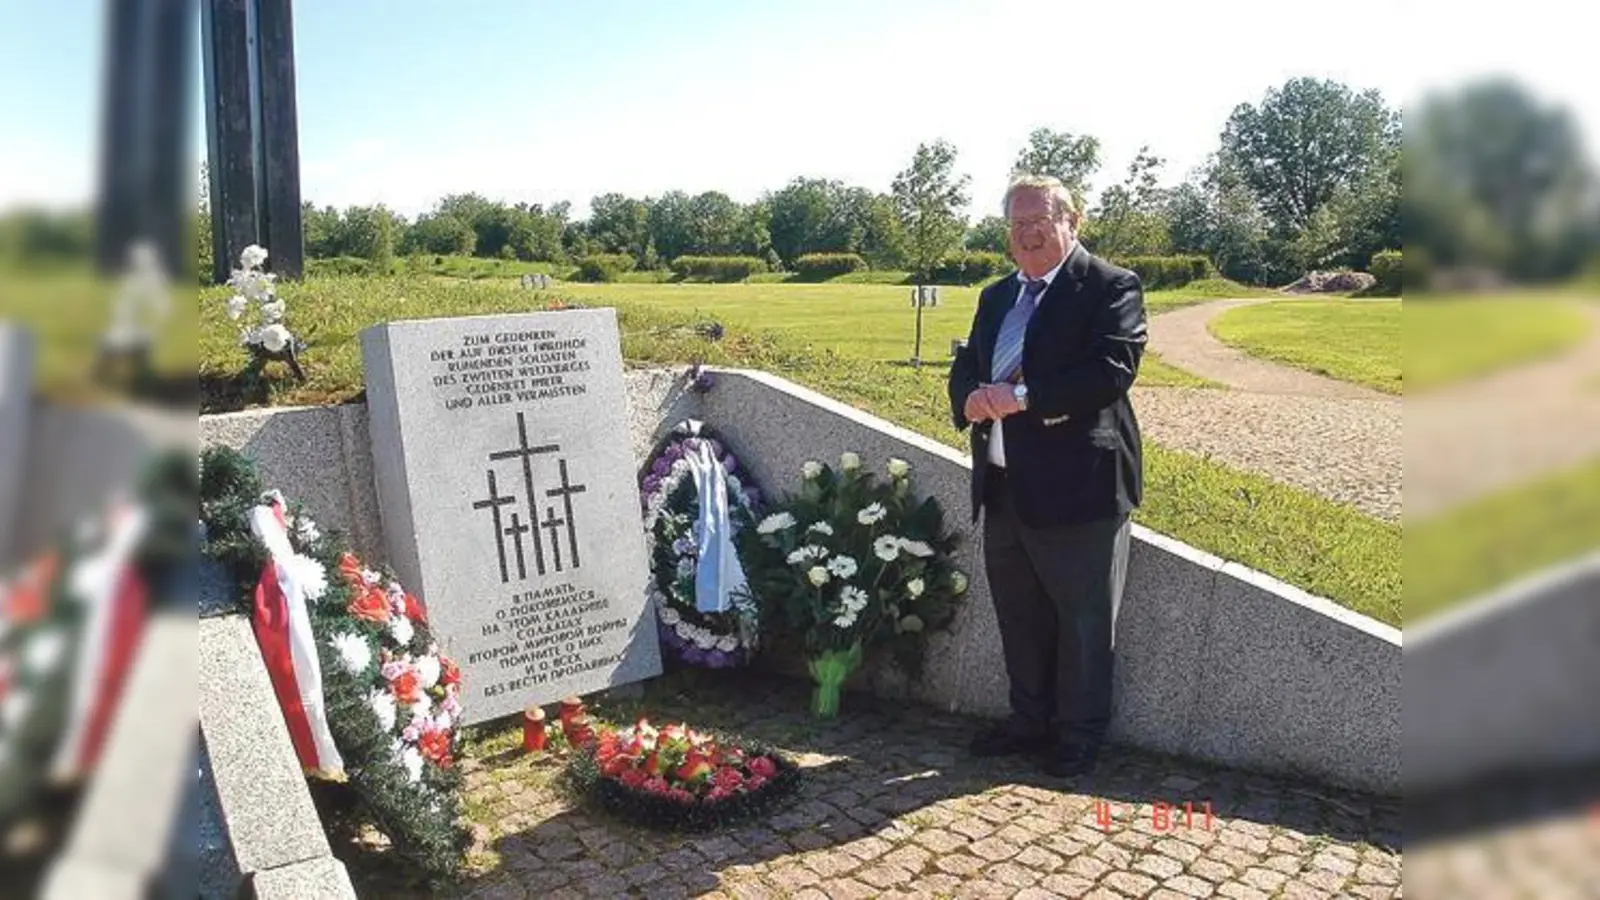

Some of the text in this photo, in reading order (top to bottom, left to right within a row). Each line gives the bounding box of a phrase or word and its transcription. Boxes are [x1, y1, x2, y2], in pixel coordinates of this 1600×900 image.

[463, 330, 556, 346] ZUM GEDENKEN
[430, 339, 586, 361] DER AUF DIESEM FRIEDHOF
[448, 350, 576, 372] RUHENDEN SOLDATEN
[433, 361, 591, 386] DES ZWEITEN WELTKRIEGES
[446, 384, 586, 410] UND ALLER VERMISSTEN
[513, 583, 575, 603] В ПАМЯТЬ
[496, 610, 505, 620] О
[469, 618, 627, 664] ВТОРОЙ МИРОВОЙ ВОЙНЫ
[482, 624, 500, 636] НА
[500, 637, 603, 669] ПОМНИТЕ О НИХ
[525, 653, 582, 674] И О ВСЕХ
[484, 684, 505, 697] БЕЗ
[509, 673, 548, 691] ВЕСТИ
